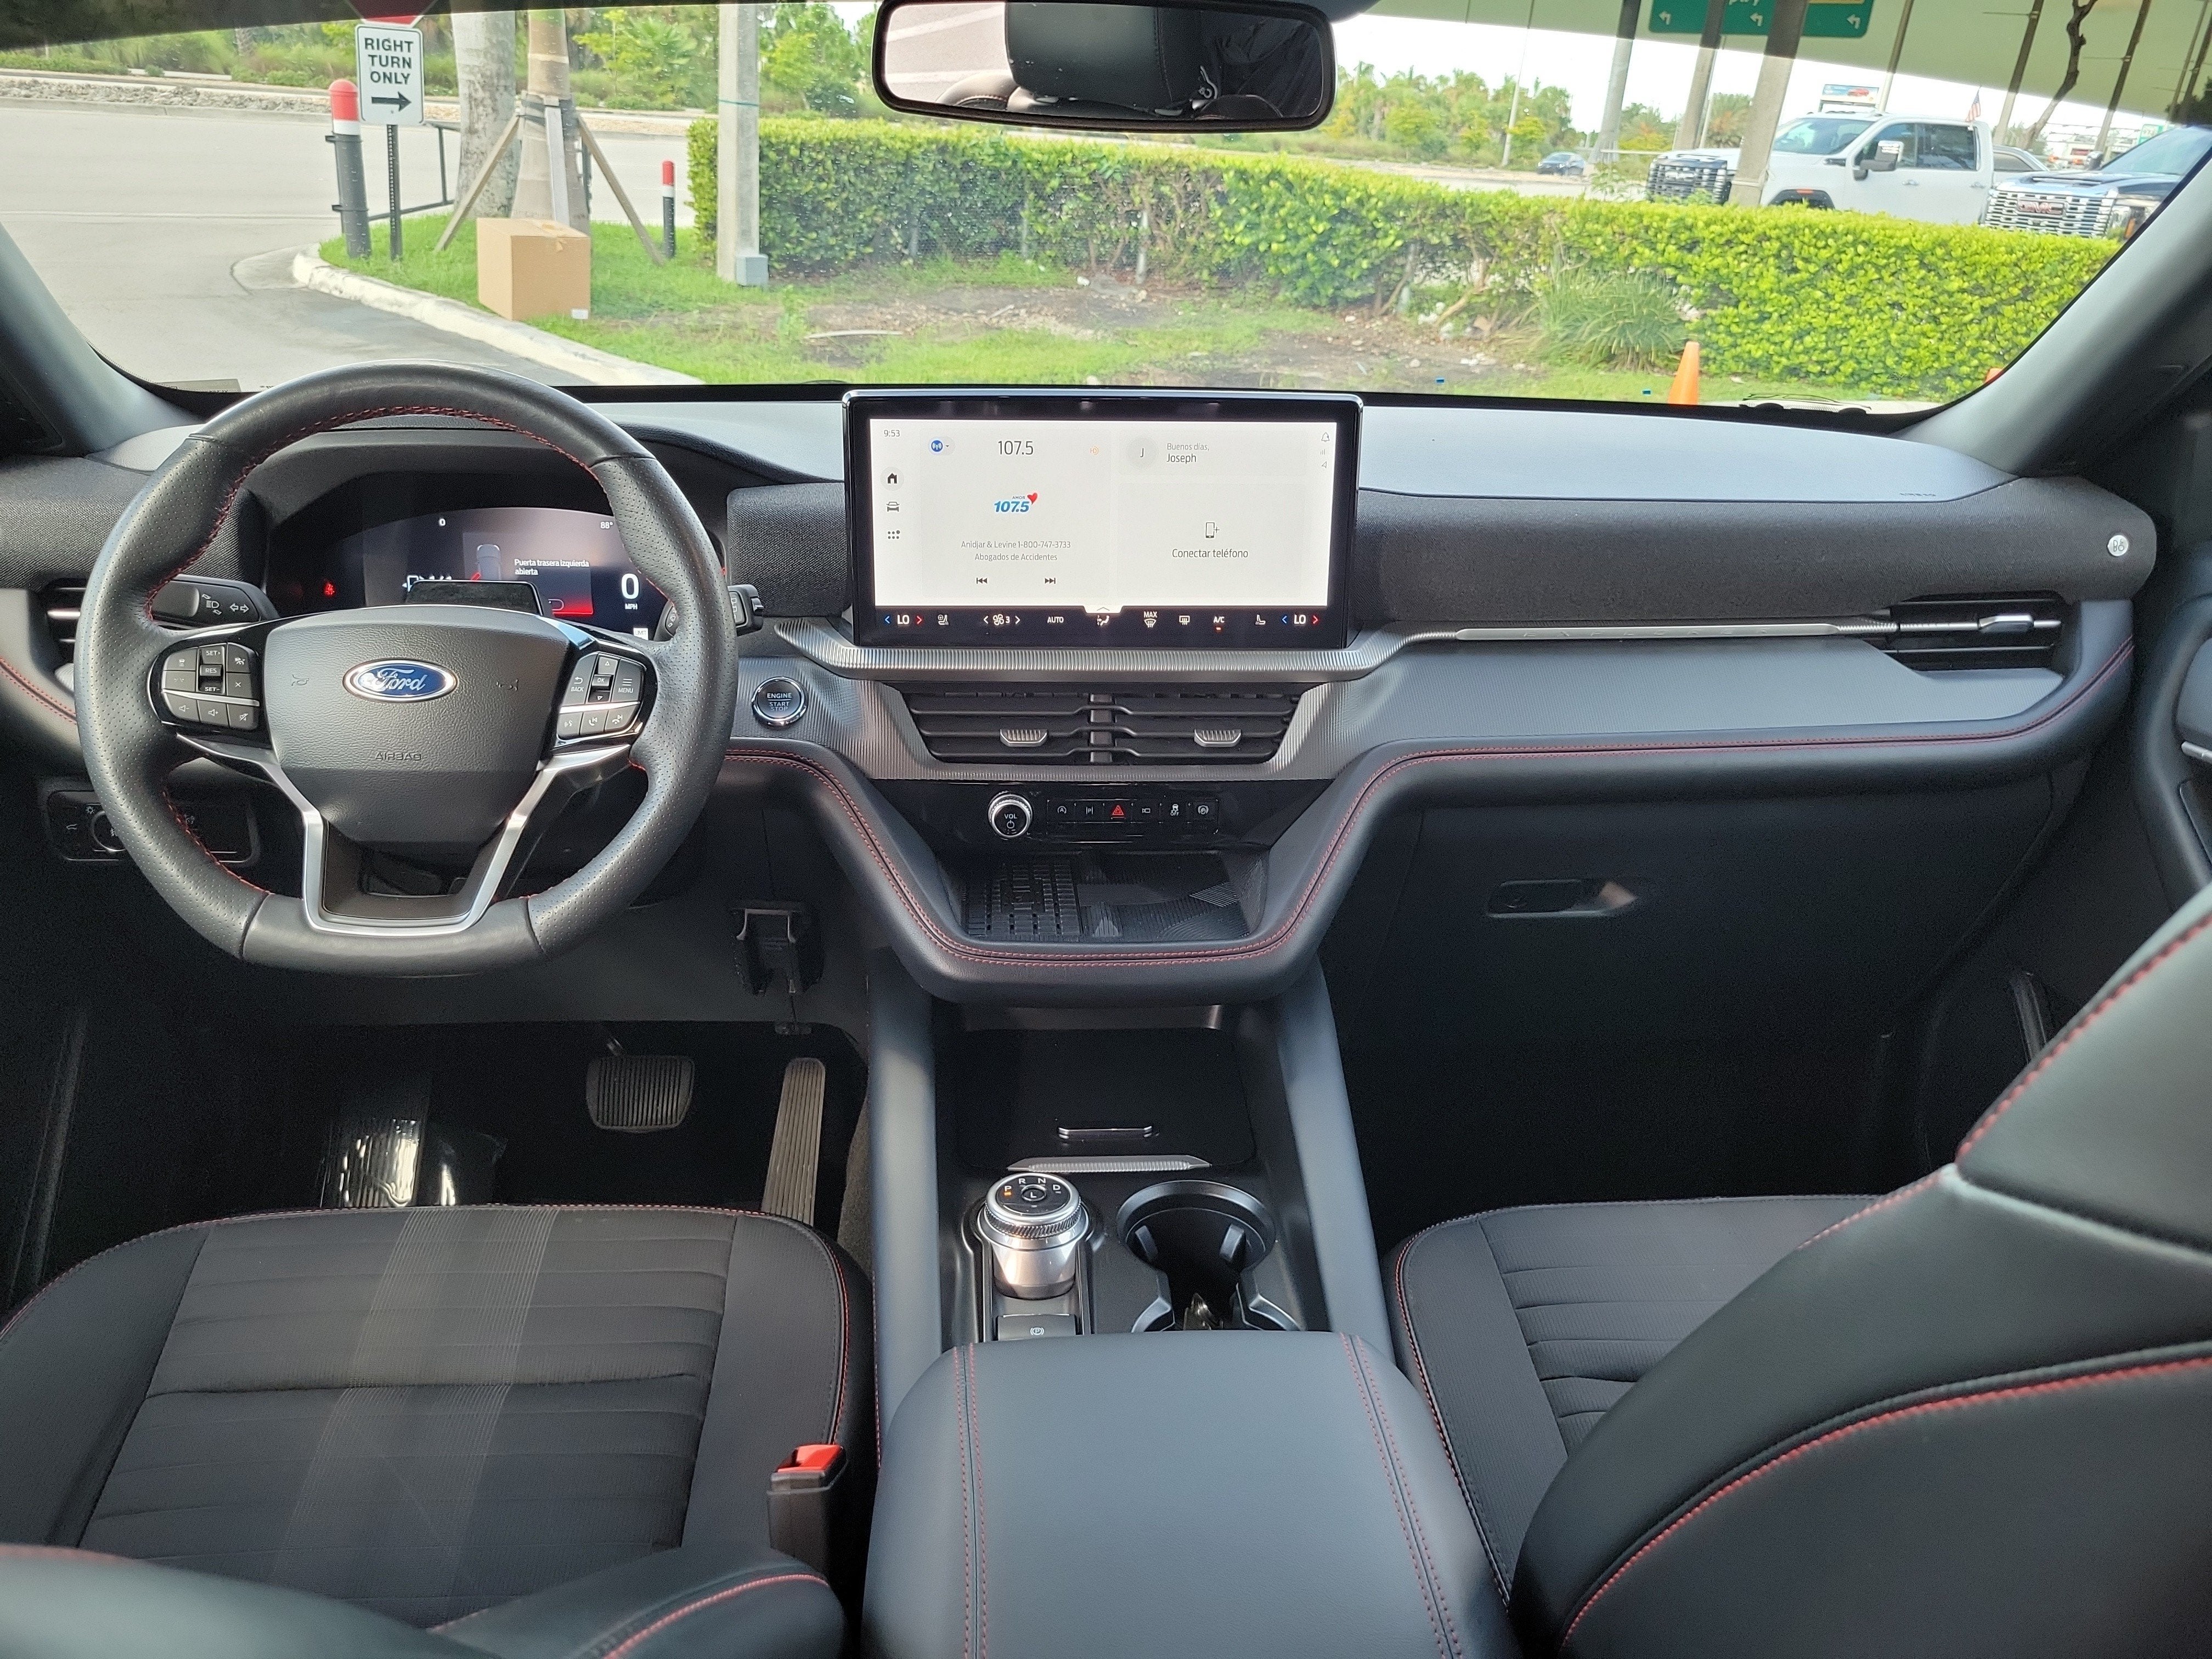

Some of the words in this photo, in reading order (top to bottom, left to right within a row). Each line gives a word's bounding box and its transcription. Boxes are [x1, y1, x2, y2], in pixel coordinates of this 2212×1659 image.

[364, 37, 414, 53] RIGHT
[368, 54, 412, 69] TURN
[370, 71, 410, 85] ONLY
[884, 429, 900, 438] 9:53
[997, 440, 1034, 455] 107.5
[1166, 442, 1192, 451] Buenos
[1193, 442, 1210, 452] días,
[1140, 447, 1144, 458] J
[1166, 453, 1197, 464] Joseph
[994, 500, 1030, 513] 107.5
[961, 540, 985, 550] Anidjar
[974, 554, 1009, 562] Abogados
[1172, 549, 1210, 558] Conectar
[1212, 549, 1249, 558] teléfono
[620, 573, 640, 600] 0
[897, 614, 910, 624] LO
[1005, 616, 1011, 624] 3
[1213, 616, 1225, 624] A/C
[1294, 614, 1307, 624] LO
[375, 668, 427, 691] Ford
[375, 752, 422, 761] AIRBAG
